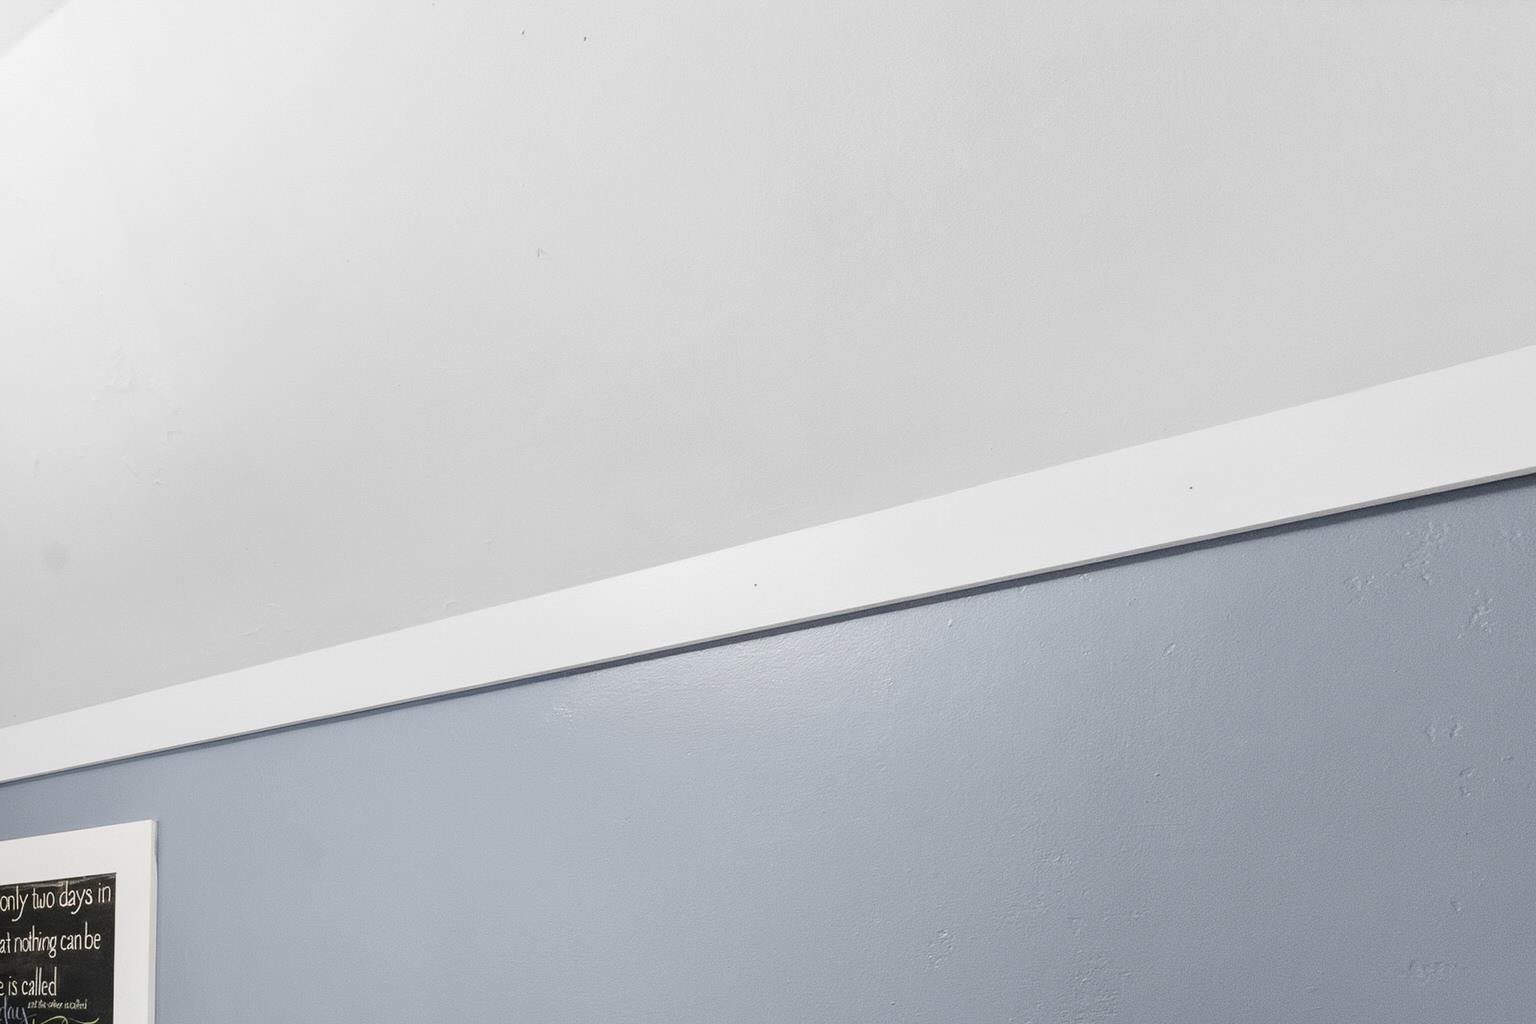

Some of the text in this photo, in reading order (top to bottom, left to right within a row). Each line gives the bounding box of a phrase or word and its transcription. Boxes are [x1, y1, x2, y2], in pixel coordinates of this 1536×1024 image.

[0, 885, 29, 922] only
[32, 887, 55, 910] two
[58, 880, 93, 915] days
[97, 882, 112, 904] in
[14, 925, 57, 959] nothing
[60, 933, 82, 951] can
[84, 921, 102, 950] be
[7, 975, 18, 997] is
[21, 966, 57, 997] called
